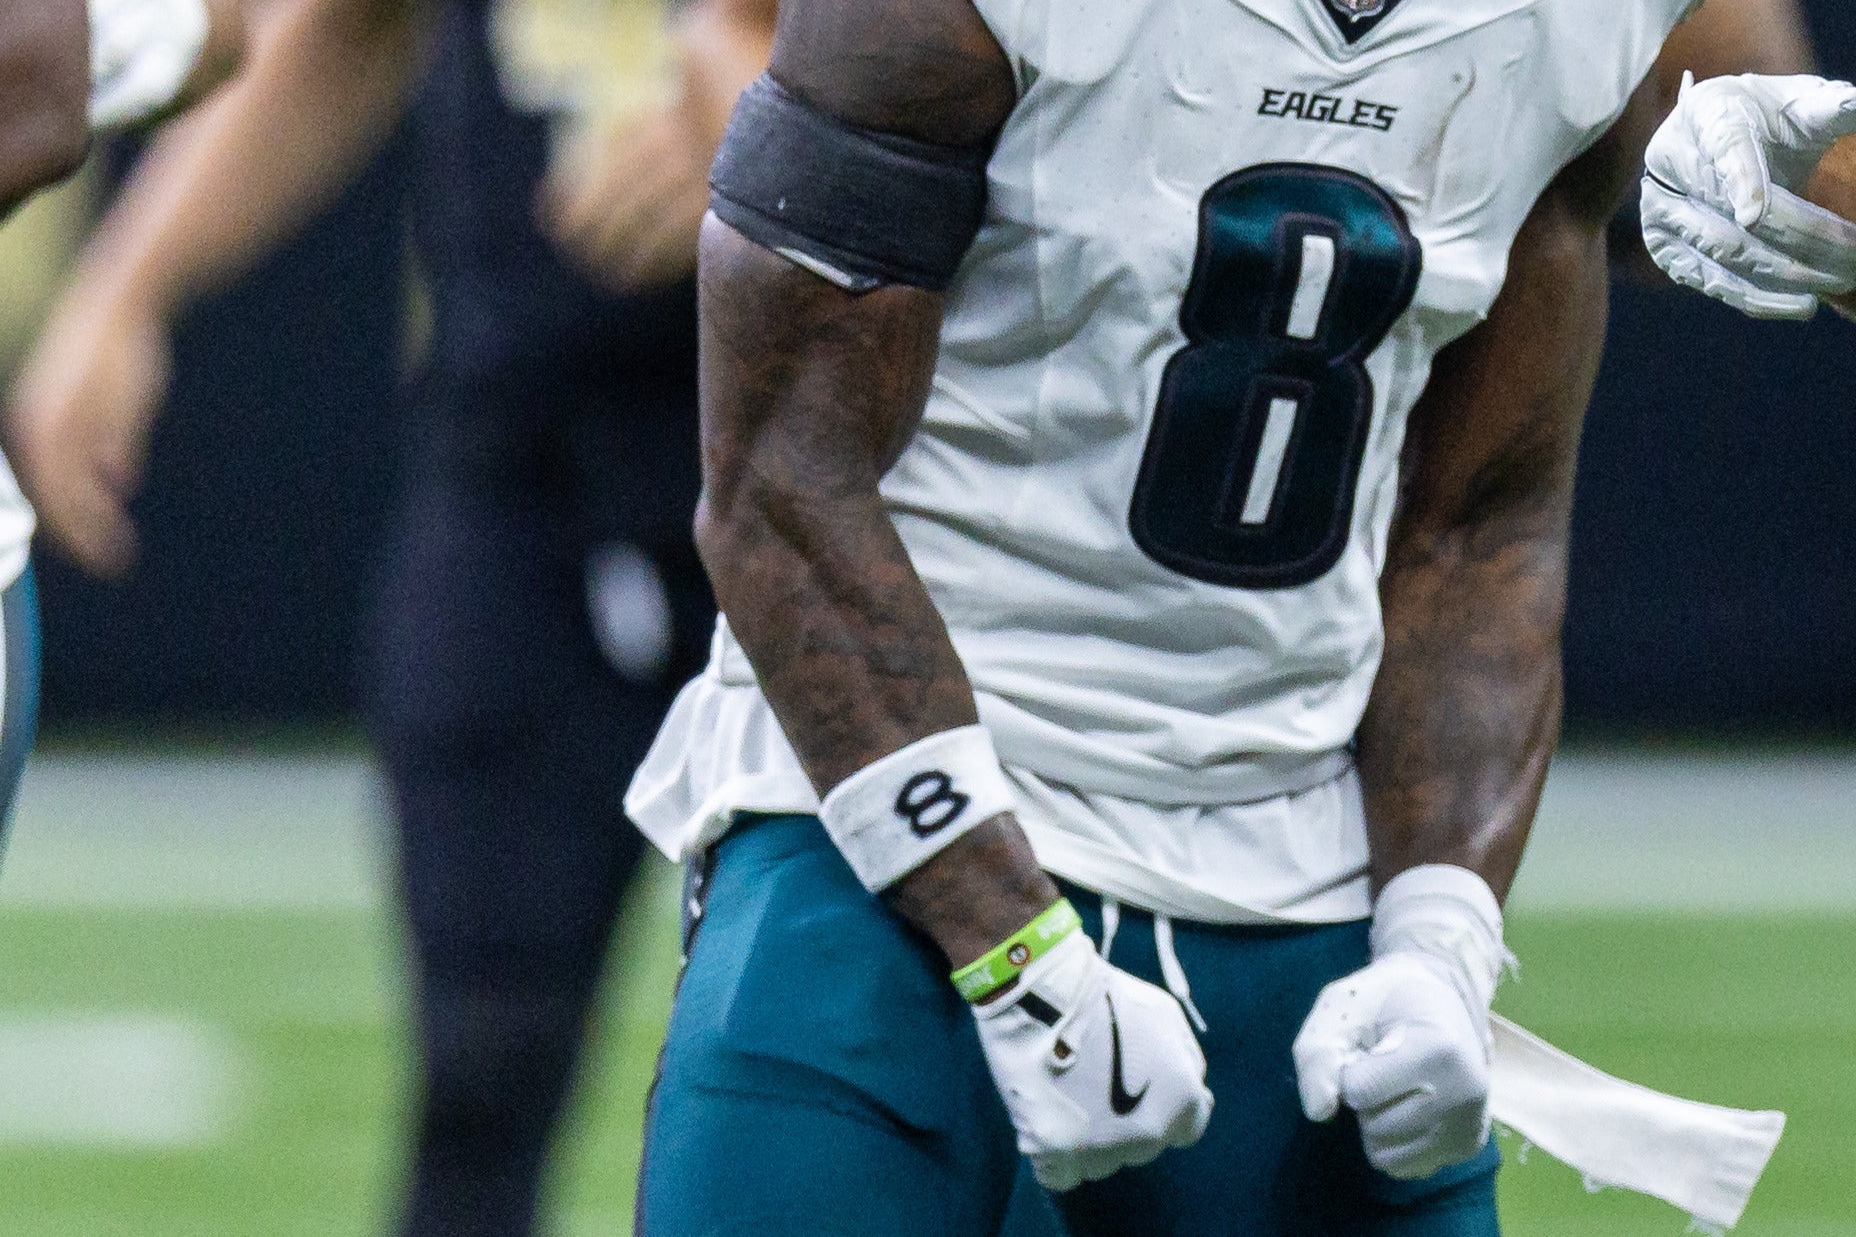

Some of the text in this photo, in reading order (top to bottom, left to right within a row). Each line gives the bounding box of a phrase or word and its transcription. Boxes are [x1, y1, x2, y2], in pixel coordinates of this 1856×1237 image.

[1257, 88, 1399, 132] EAGLES
[1128, 161, 1422, 590] 8
[895, 769, 971, 839] 8
